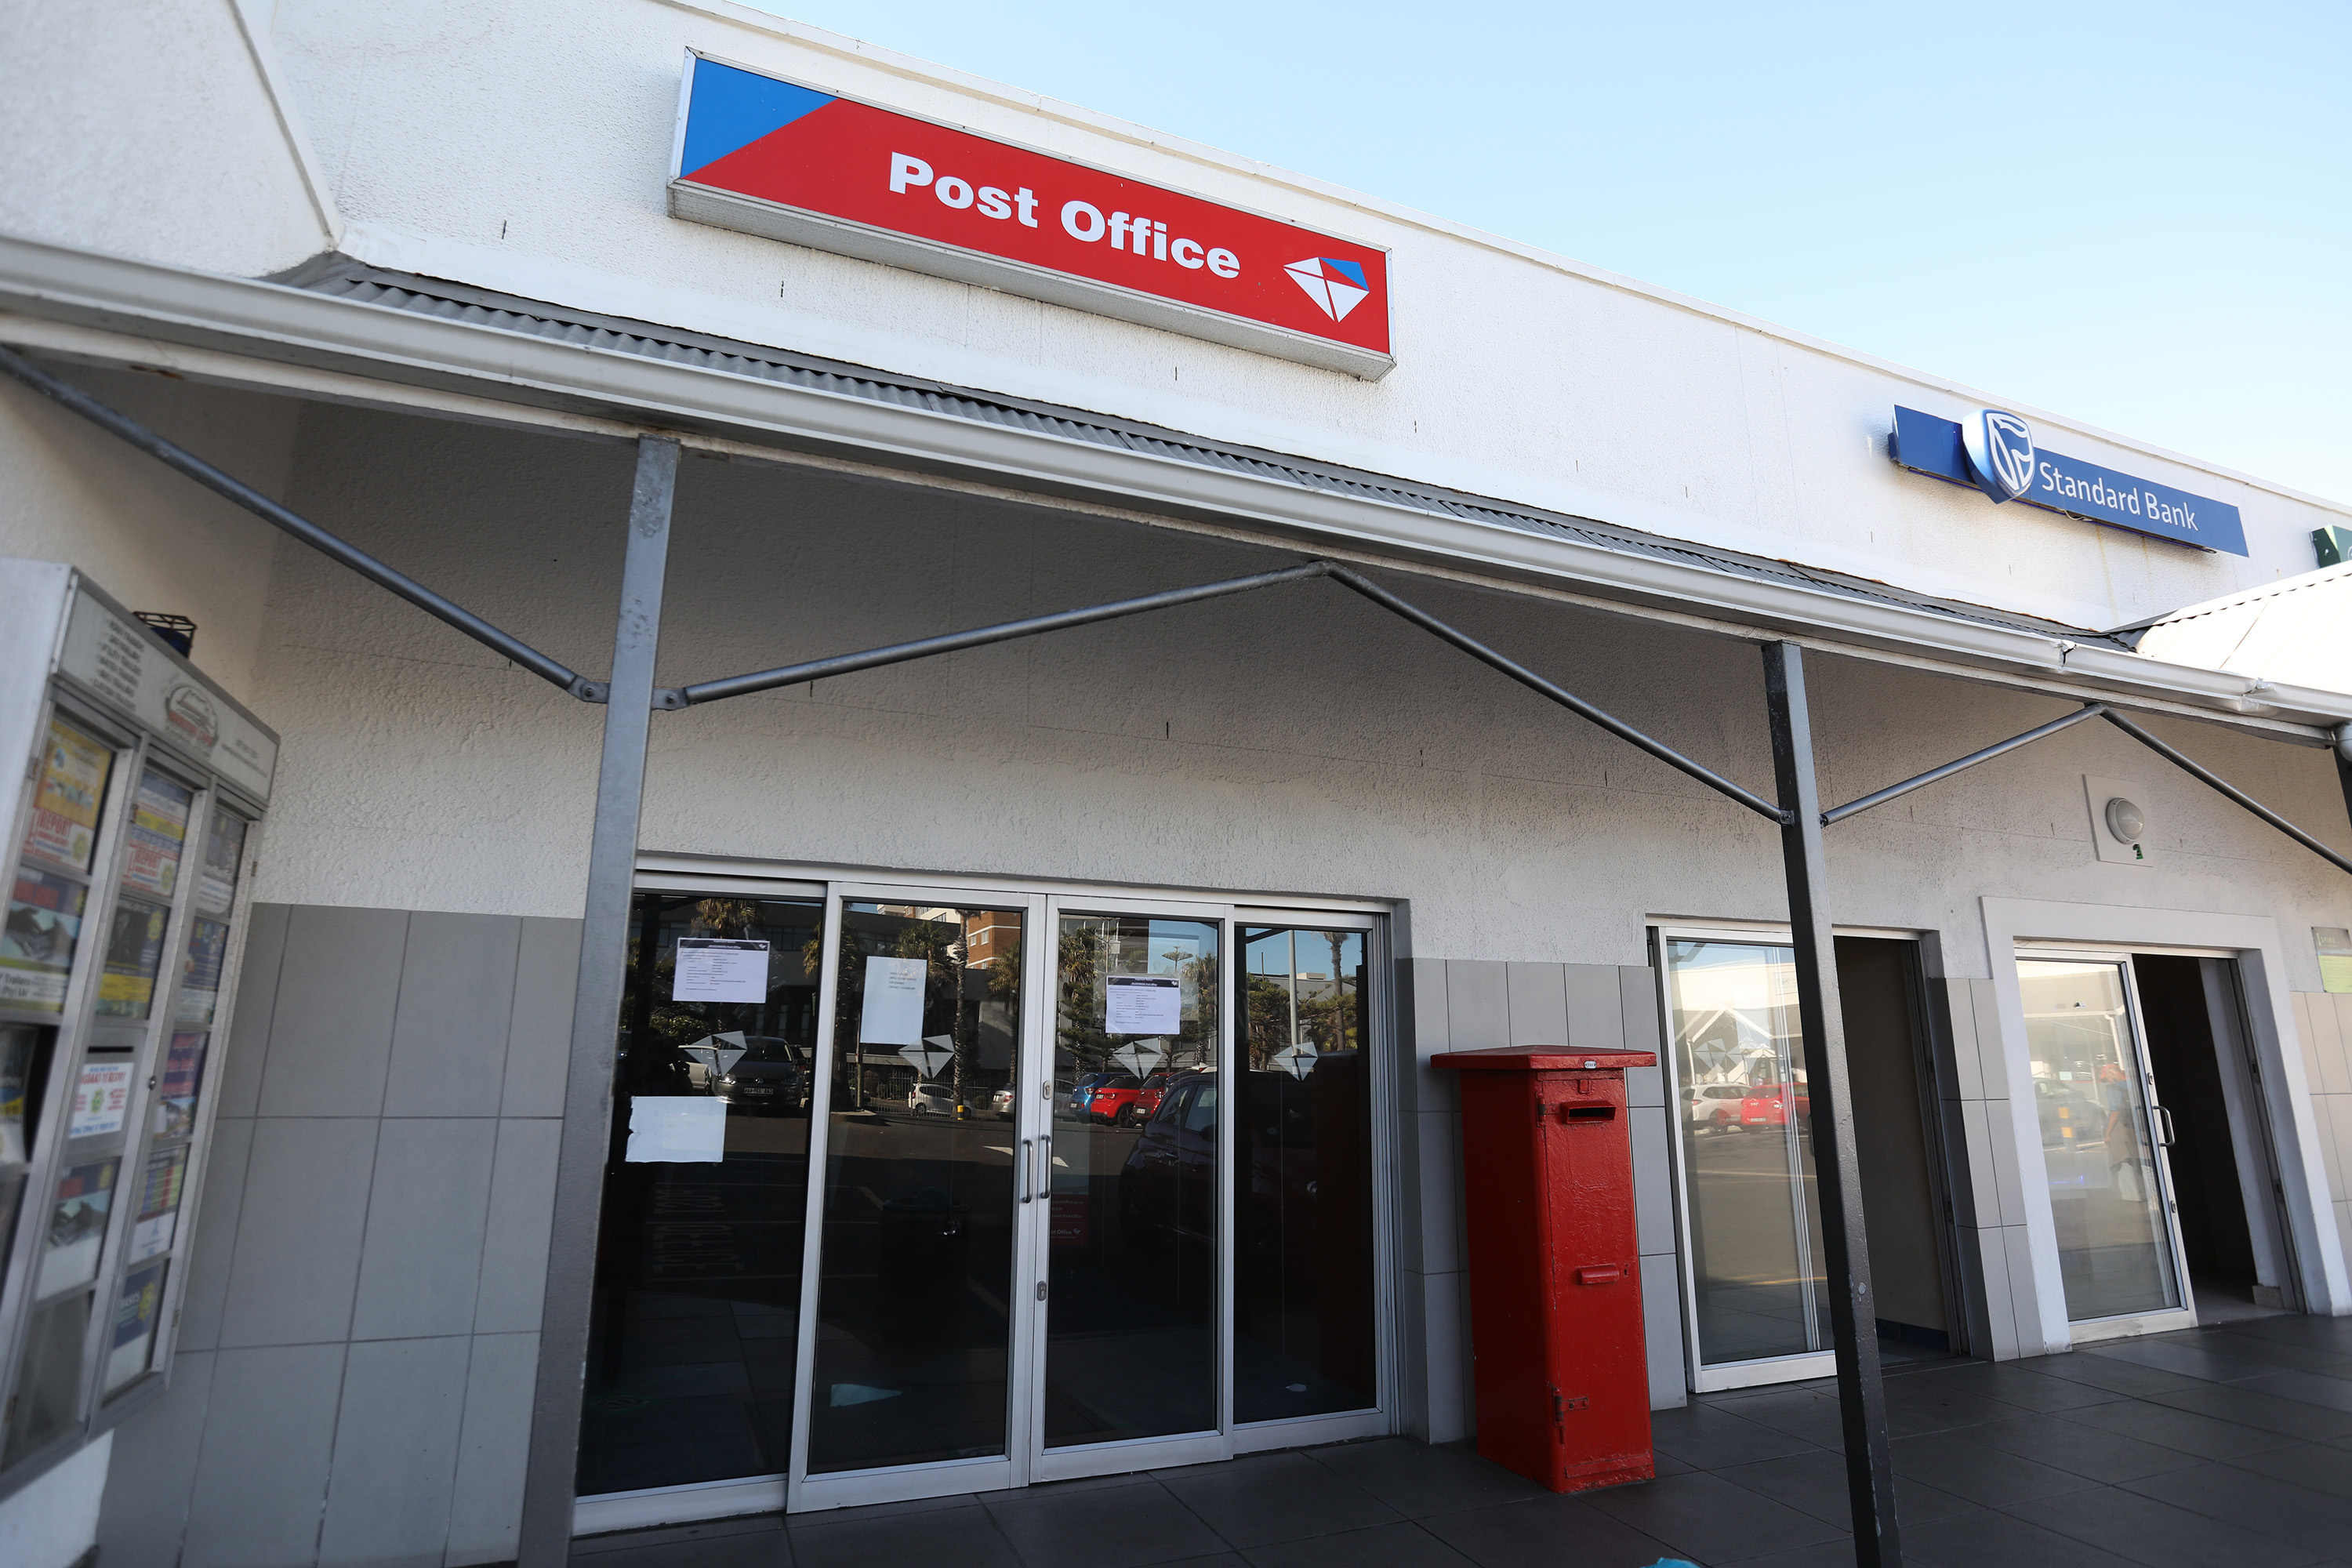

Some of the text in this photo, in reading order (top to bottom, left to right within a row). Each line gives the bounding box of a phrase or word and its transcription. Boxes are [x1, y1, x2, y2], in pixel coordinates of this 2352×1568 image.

[888, 152, 1241, 280] Post Office
[2038, 461, 2200, 532] Standard Bank
[38, 809, 74, 837] REPORT
[2132, 844, 2144, 860] 1
[5, 973, 31, 985] Trailers
